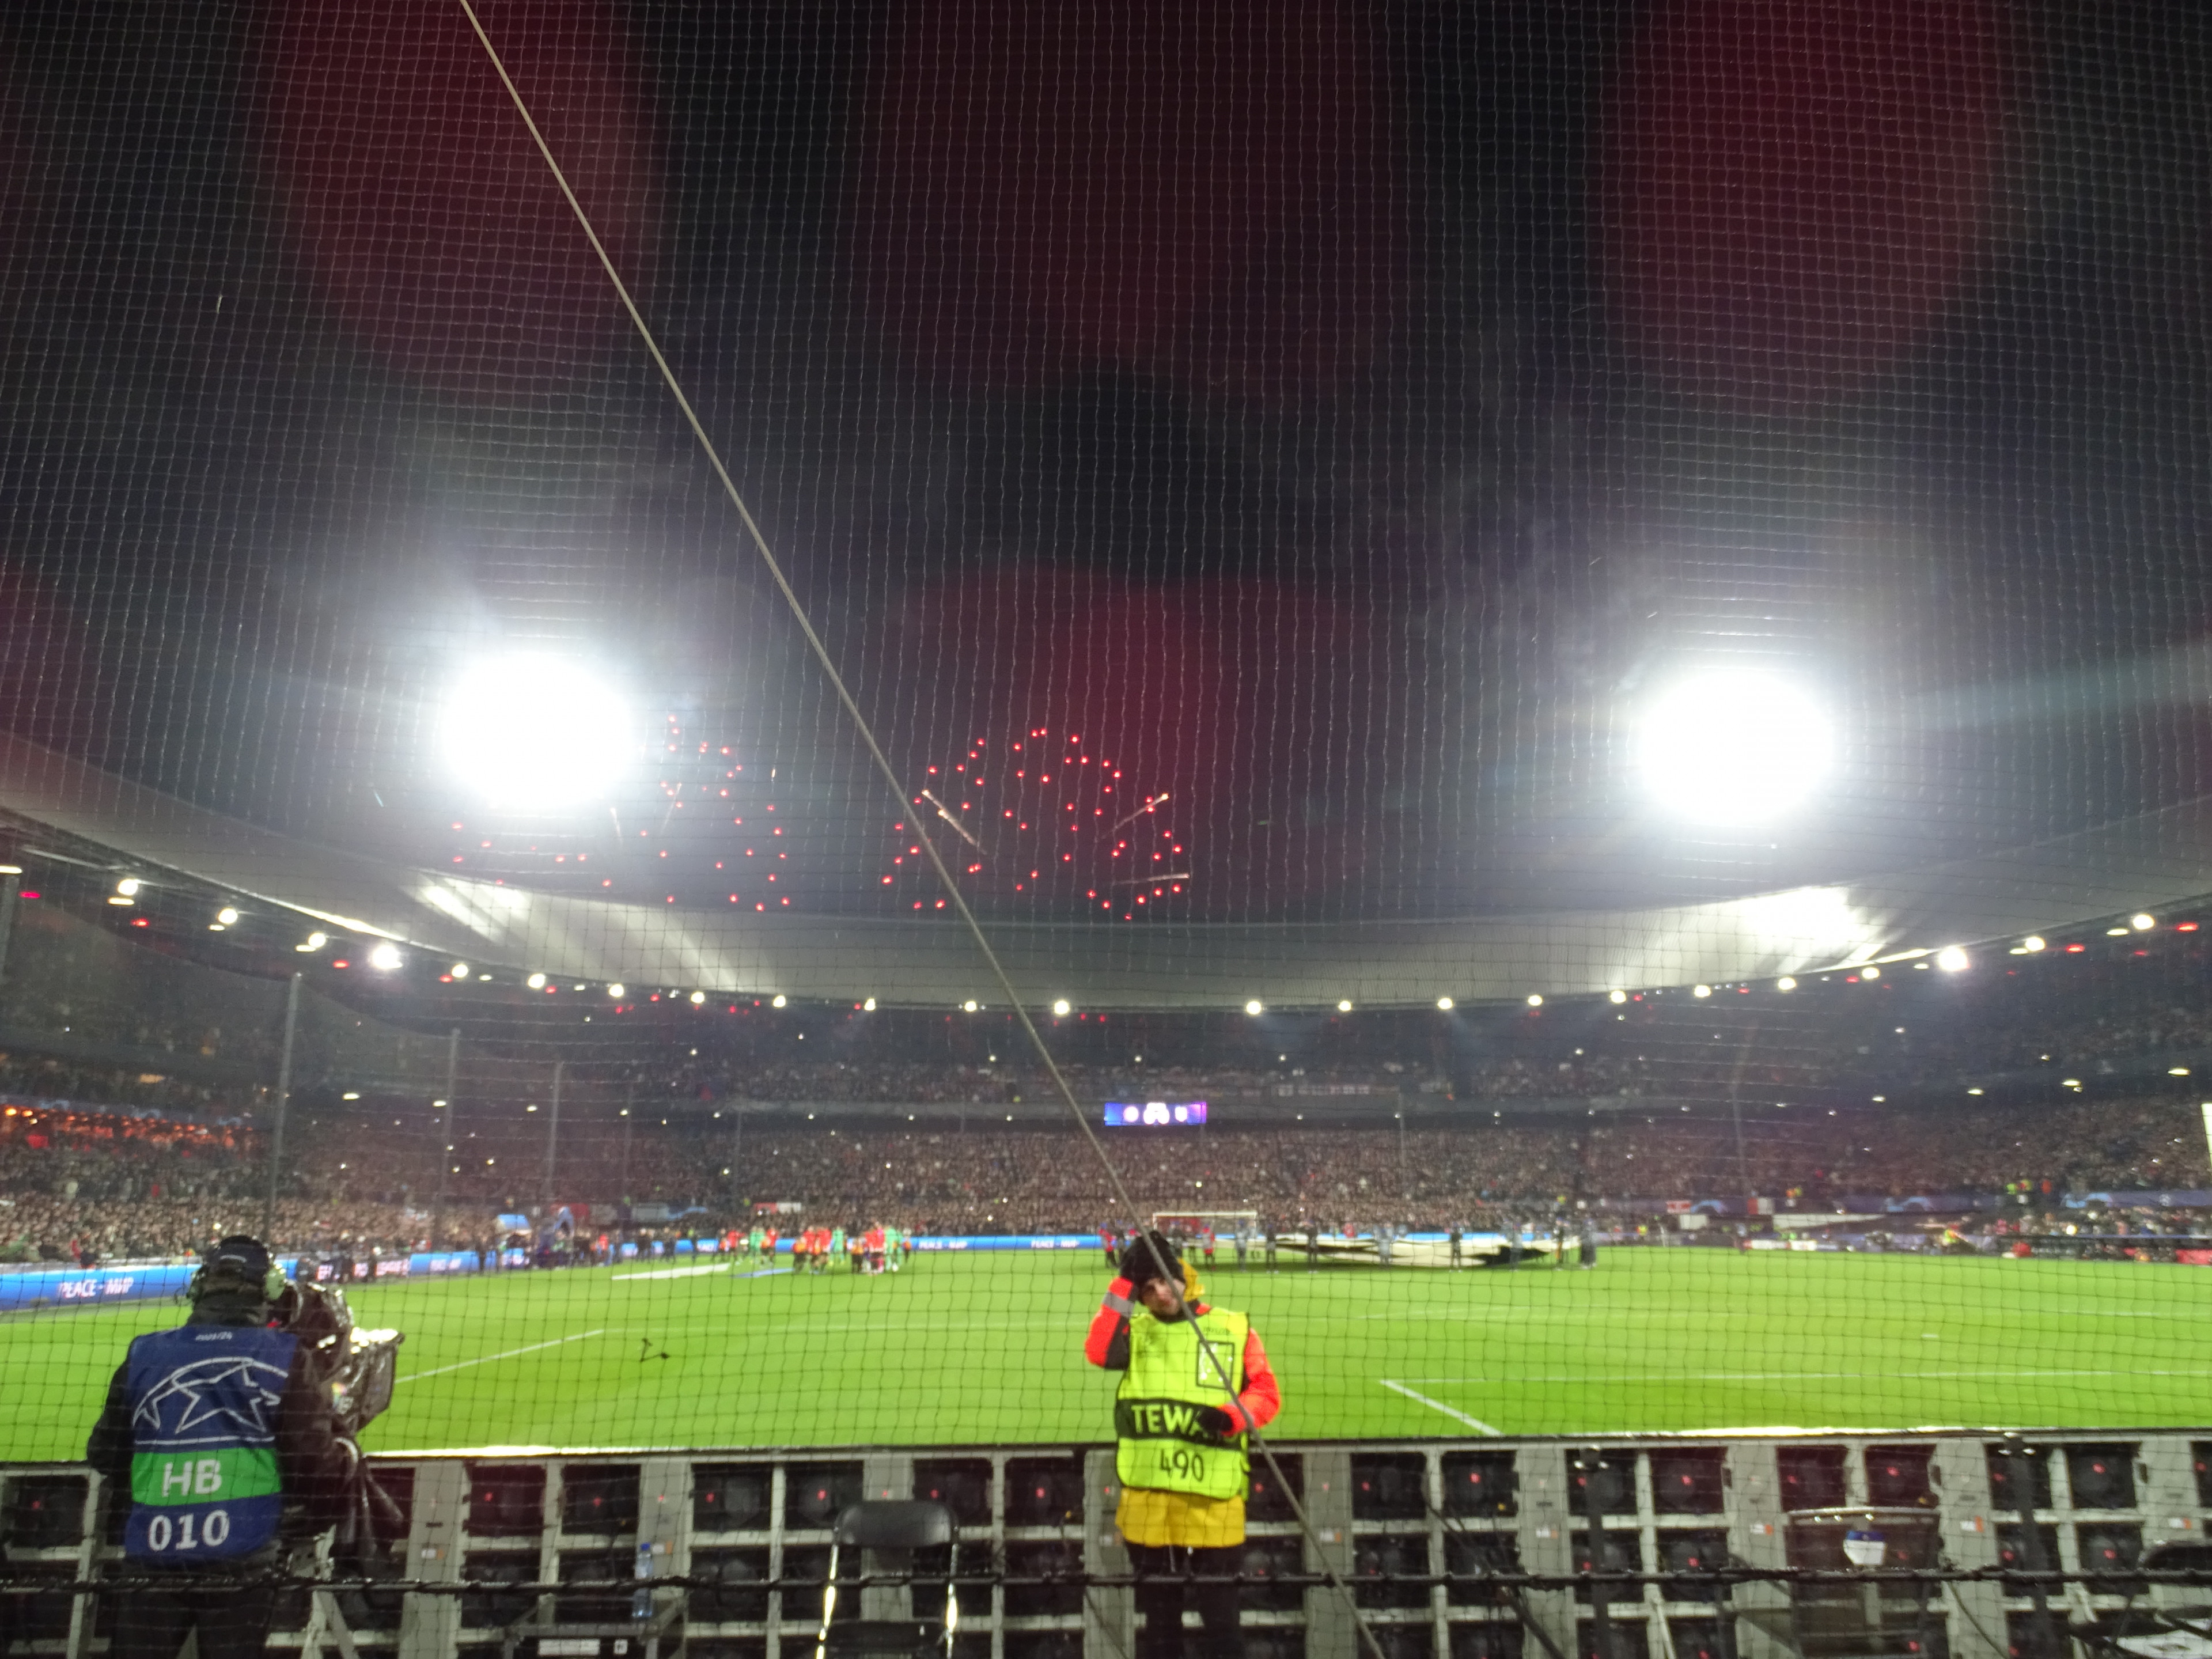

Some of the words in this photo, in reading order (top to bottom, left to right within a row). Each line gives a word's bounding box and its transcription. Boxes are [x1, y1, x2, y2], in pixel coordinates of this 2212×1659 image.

[59, 1279, 98, 1298] PEACE
[162, 1459, 222, 1497] HB
[1160, 1449, 1204, 1482] 490
[148, 1509, 230, 1551] 010
